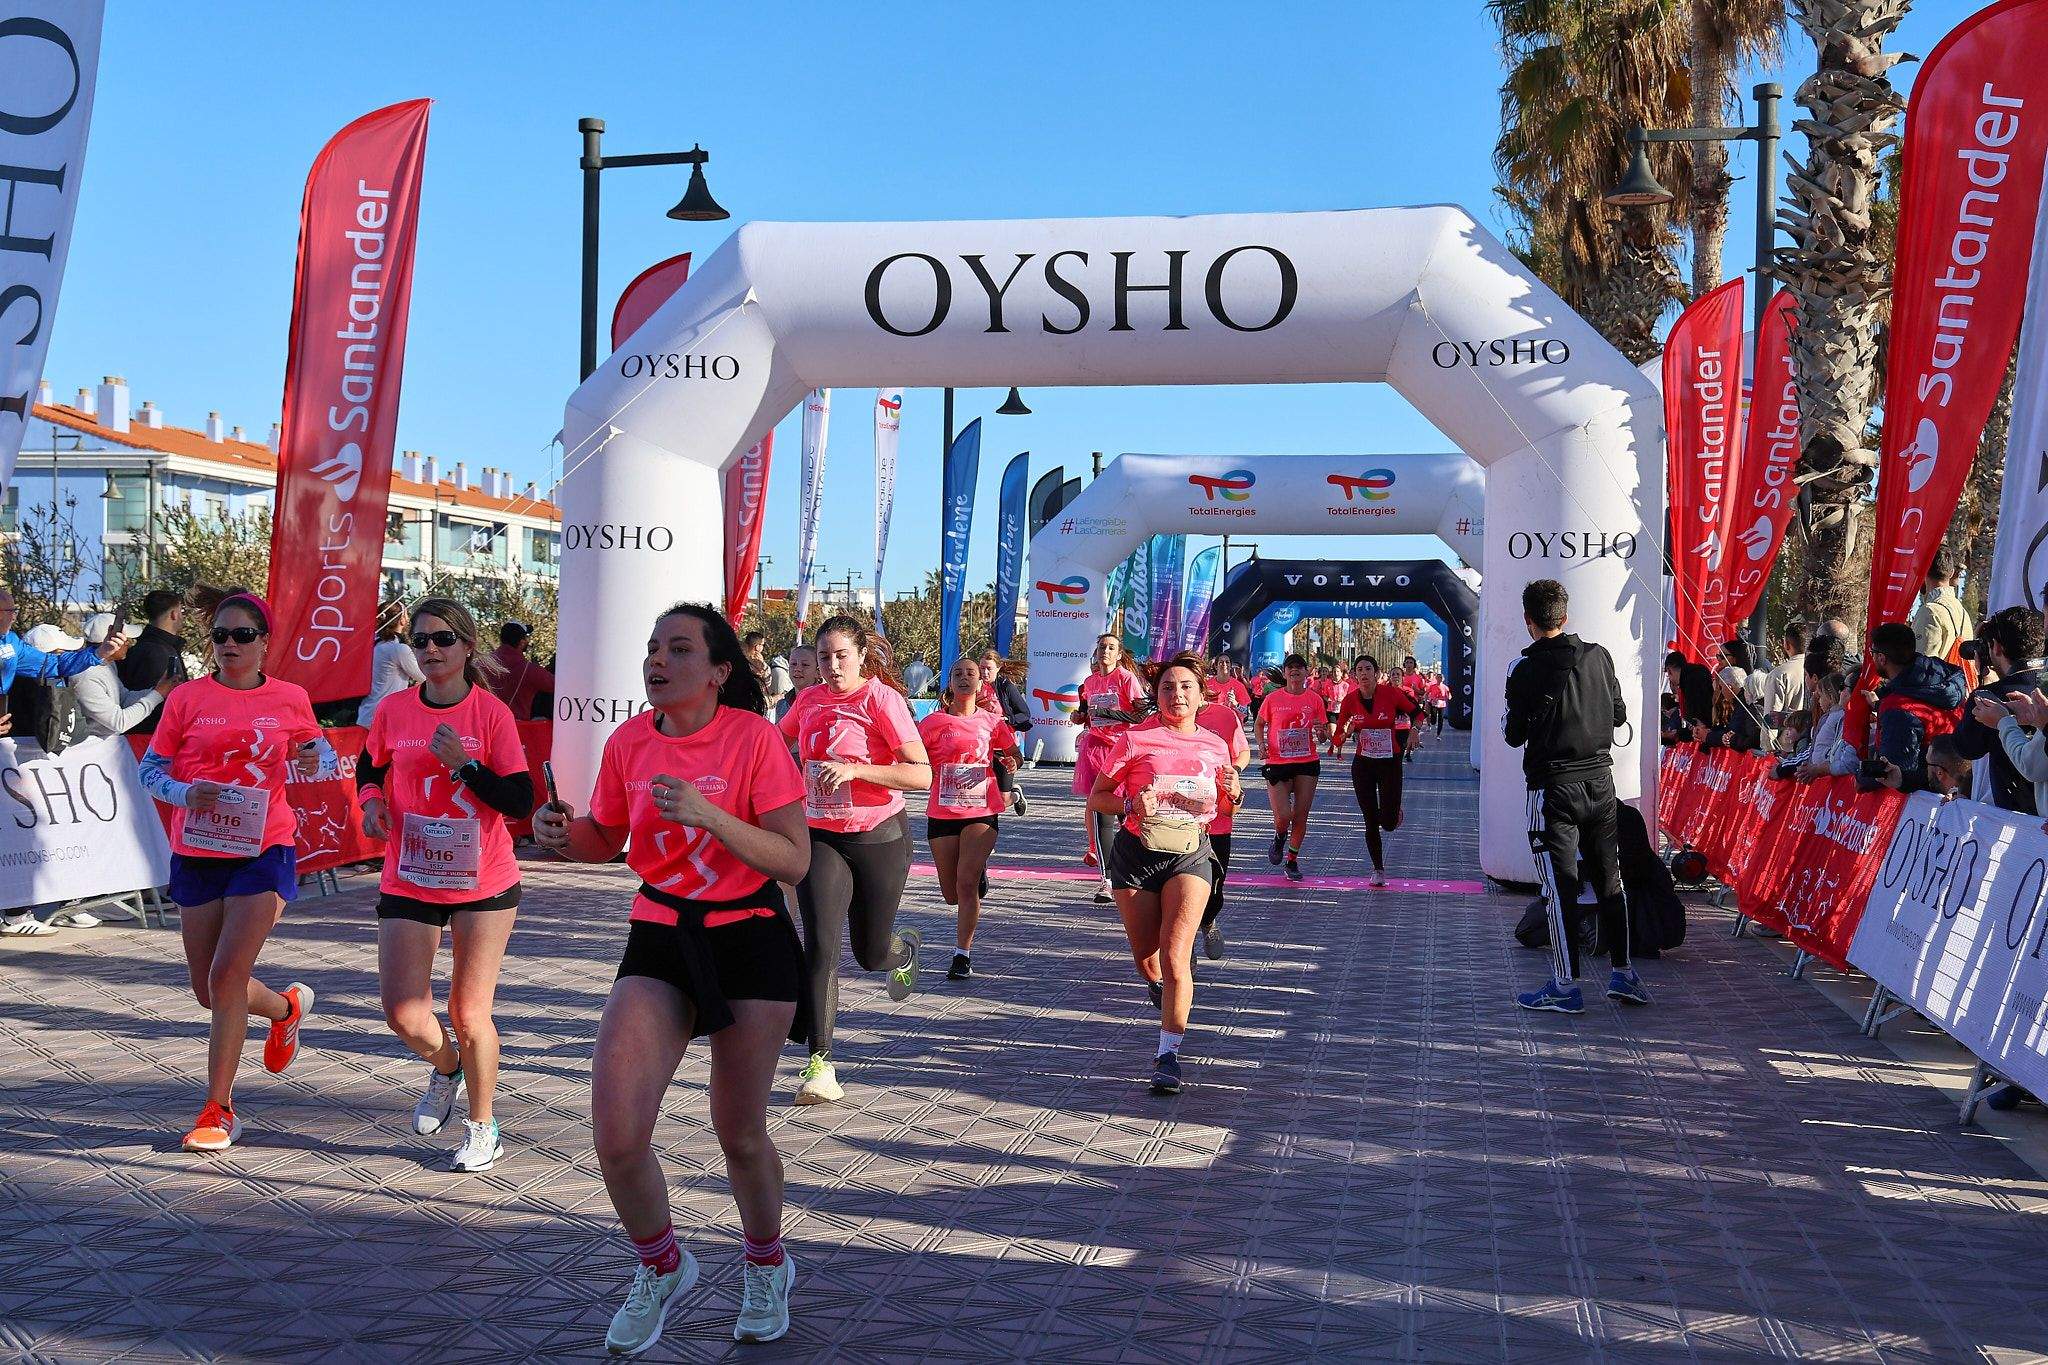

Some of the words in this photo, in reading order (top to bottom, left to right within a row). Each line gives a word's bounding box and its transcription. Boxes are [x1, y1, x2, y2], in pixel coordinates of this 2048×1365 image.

[1918, 82, 2024, 407] Santander
[864, 245, 1299, 337] OYSHO
[329, 180, 389, 432] Santander
[621, 353, 740, 381] OYSHO
[1432, 339, 1570, 368] OYSHO
[1693, 345, 1724, 523] Santander
[1188, 507, 1256, 517] TotalEnergies
[1326, 507, 1396, 517] TotalEnergies
[565, 524, 673, 552] OYSHO
[1508, 531, 1637, 560] OYSHO
[297, 512, 355, 662] Sports
[1284, 574, 1411, 587] VOLVO
[1035, 609, 1090, 620] TotalEnergies
[1033, 650, 1088, 659] totalenergies.es
[1463, 625, 1472, 717] VOLVO
[212, 813, 241, 827] 016
[424, 849, 454, 861] 016
[1884, 817, 1978, 919] OYSHO
